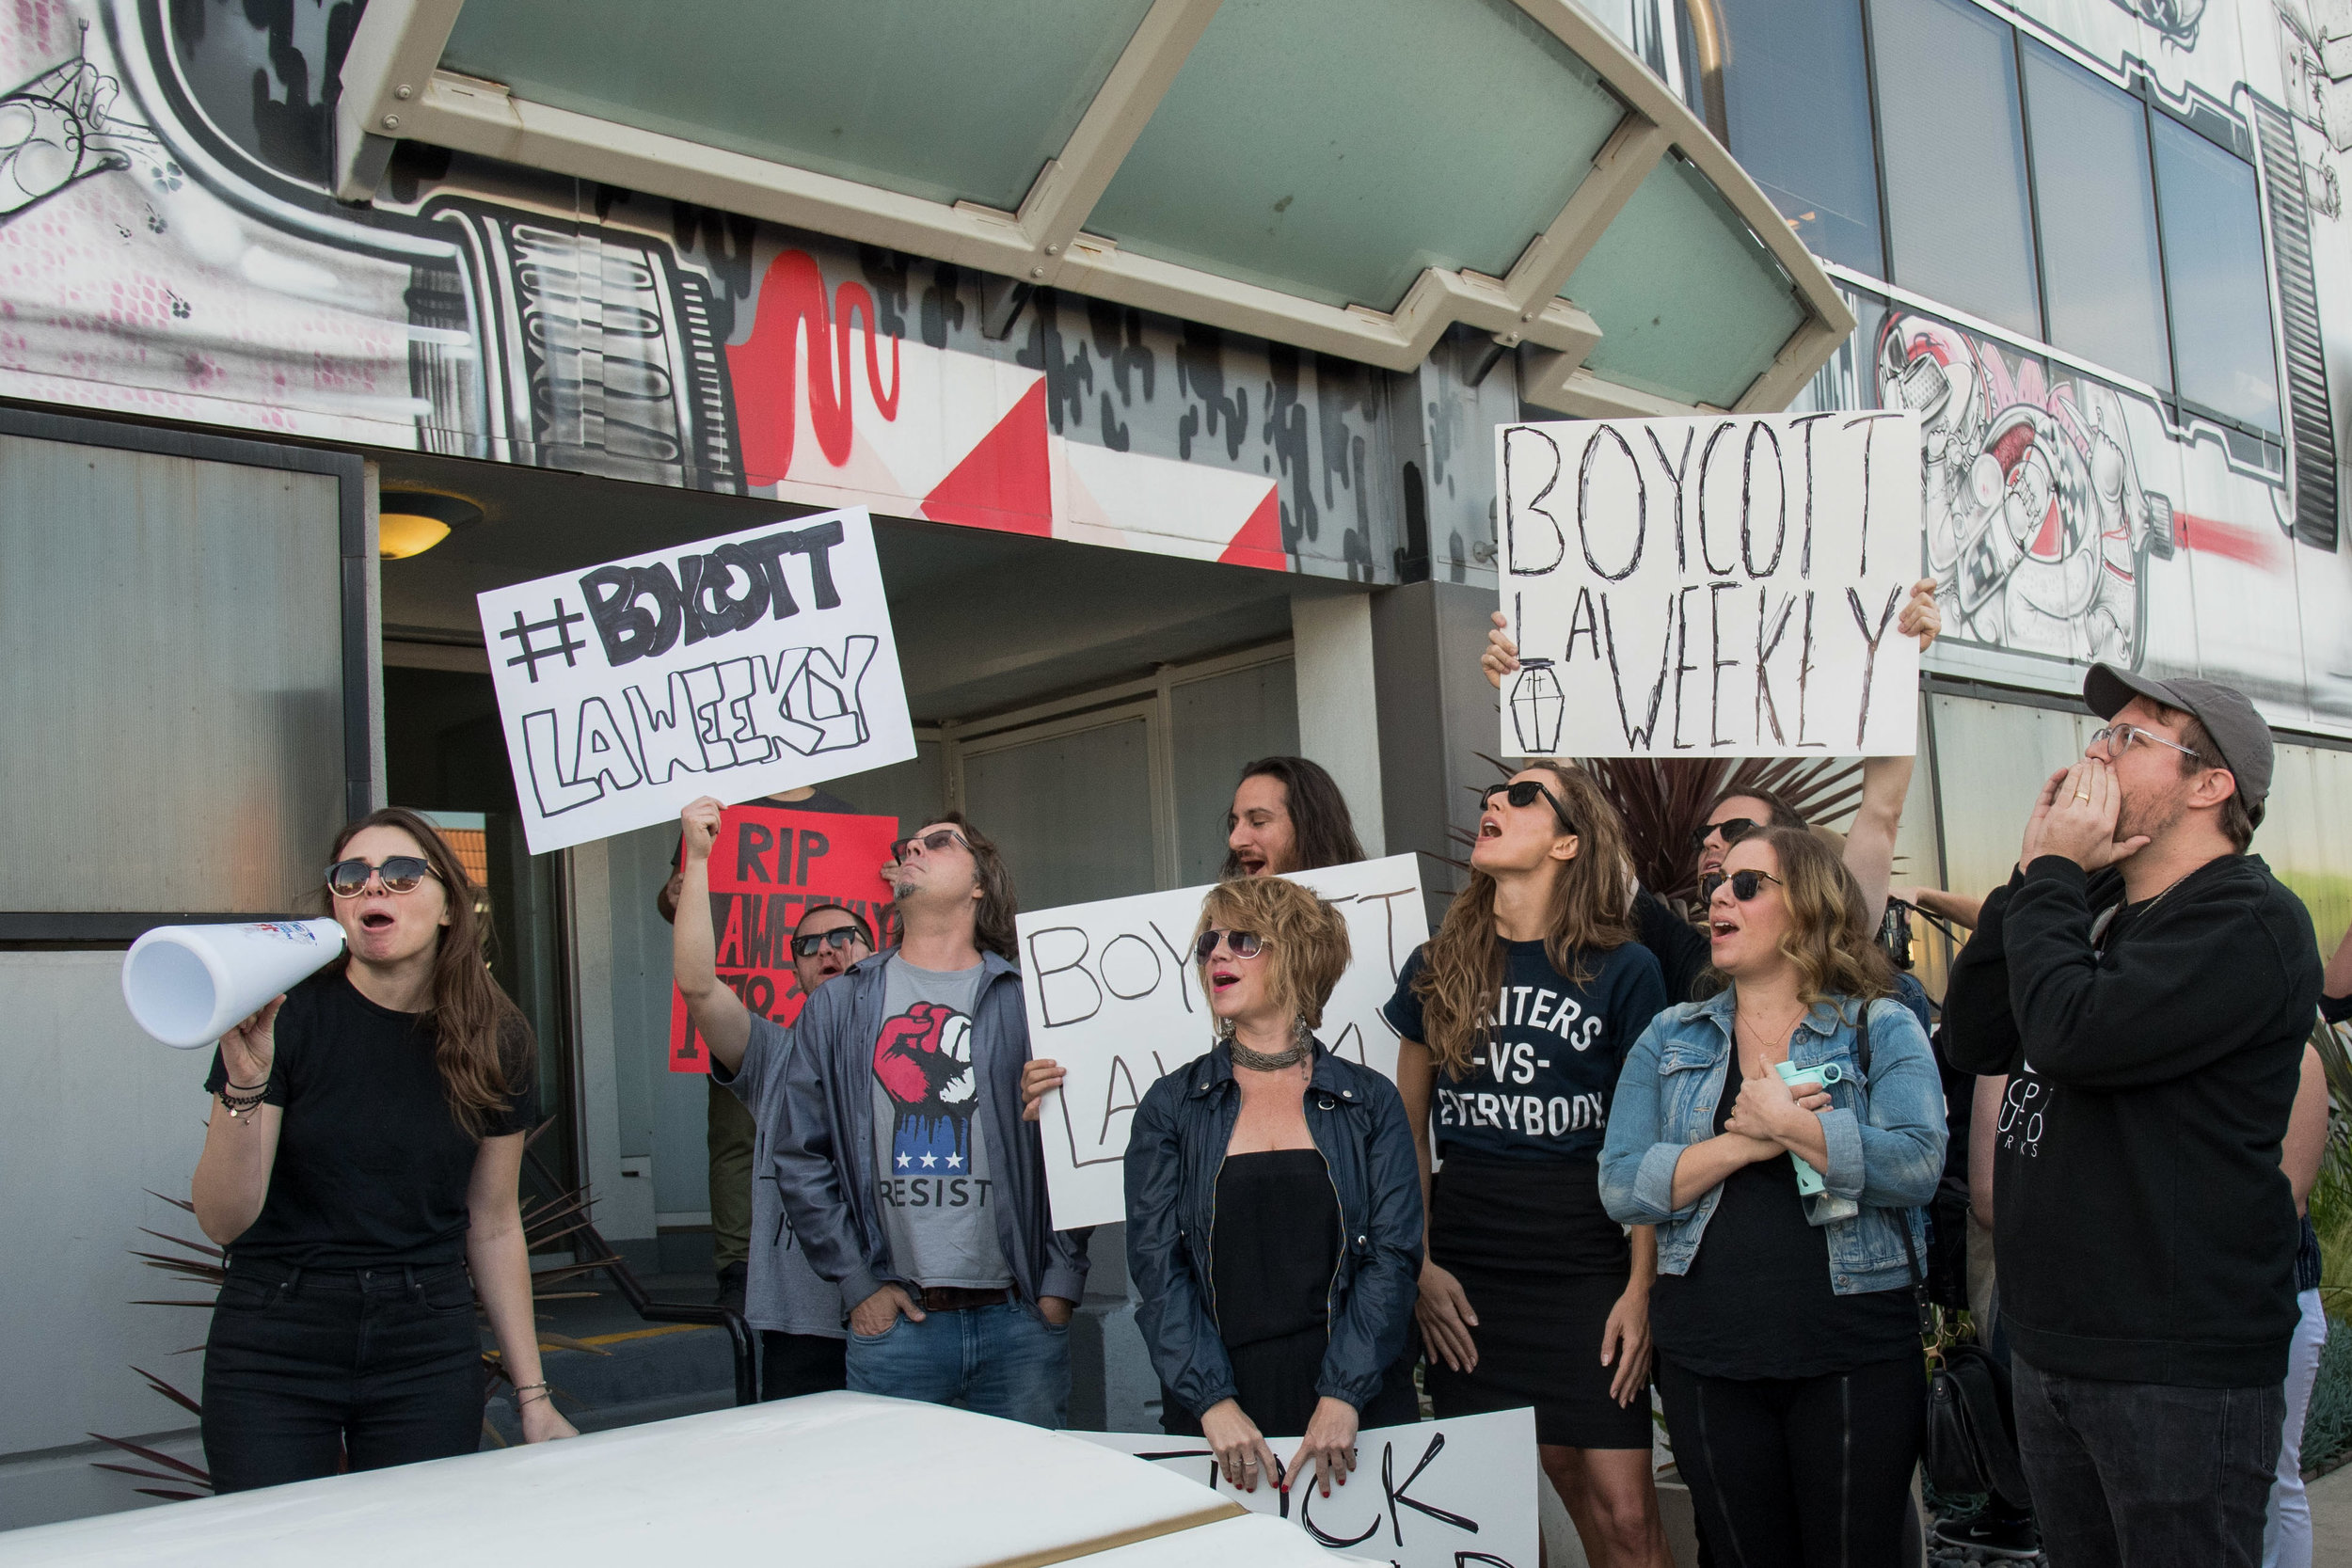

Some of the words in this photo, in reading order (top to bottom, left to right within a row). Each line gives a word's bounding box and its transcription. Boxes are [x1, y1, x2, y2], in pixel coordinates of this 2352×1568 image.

[1502, 412, 1905, 584] BOYCOTT
[1516, 585, 1600, 668] LA
[1599, 580, 1903, 752] WEEKLY
[736, 822, 831, 887] RIP
[880, 1178, 993, 1208] RESIST
